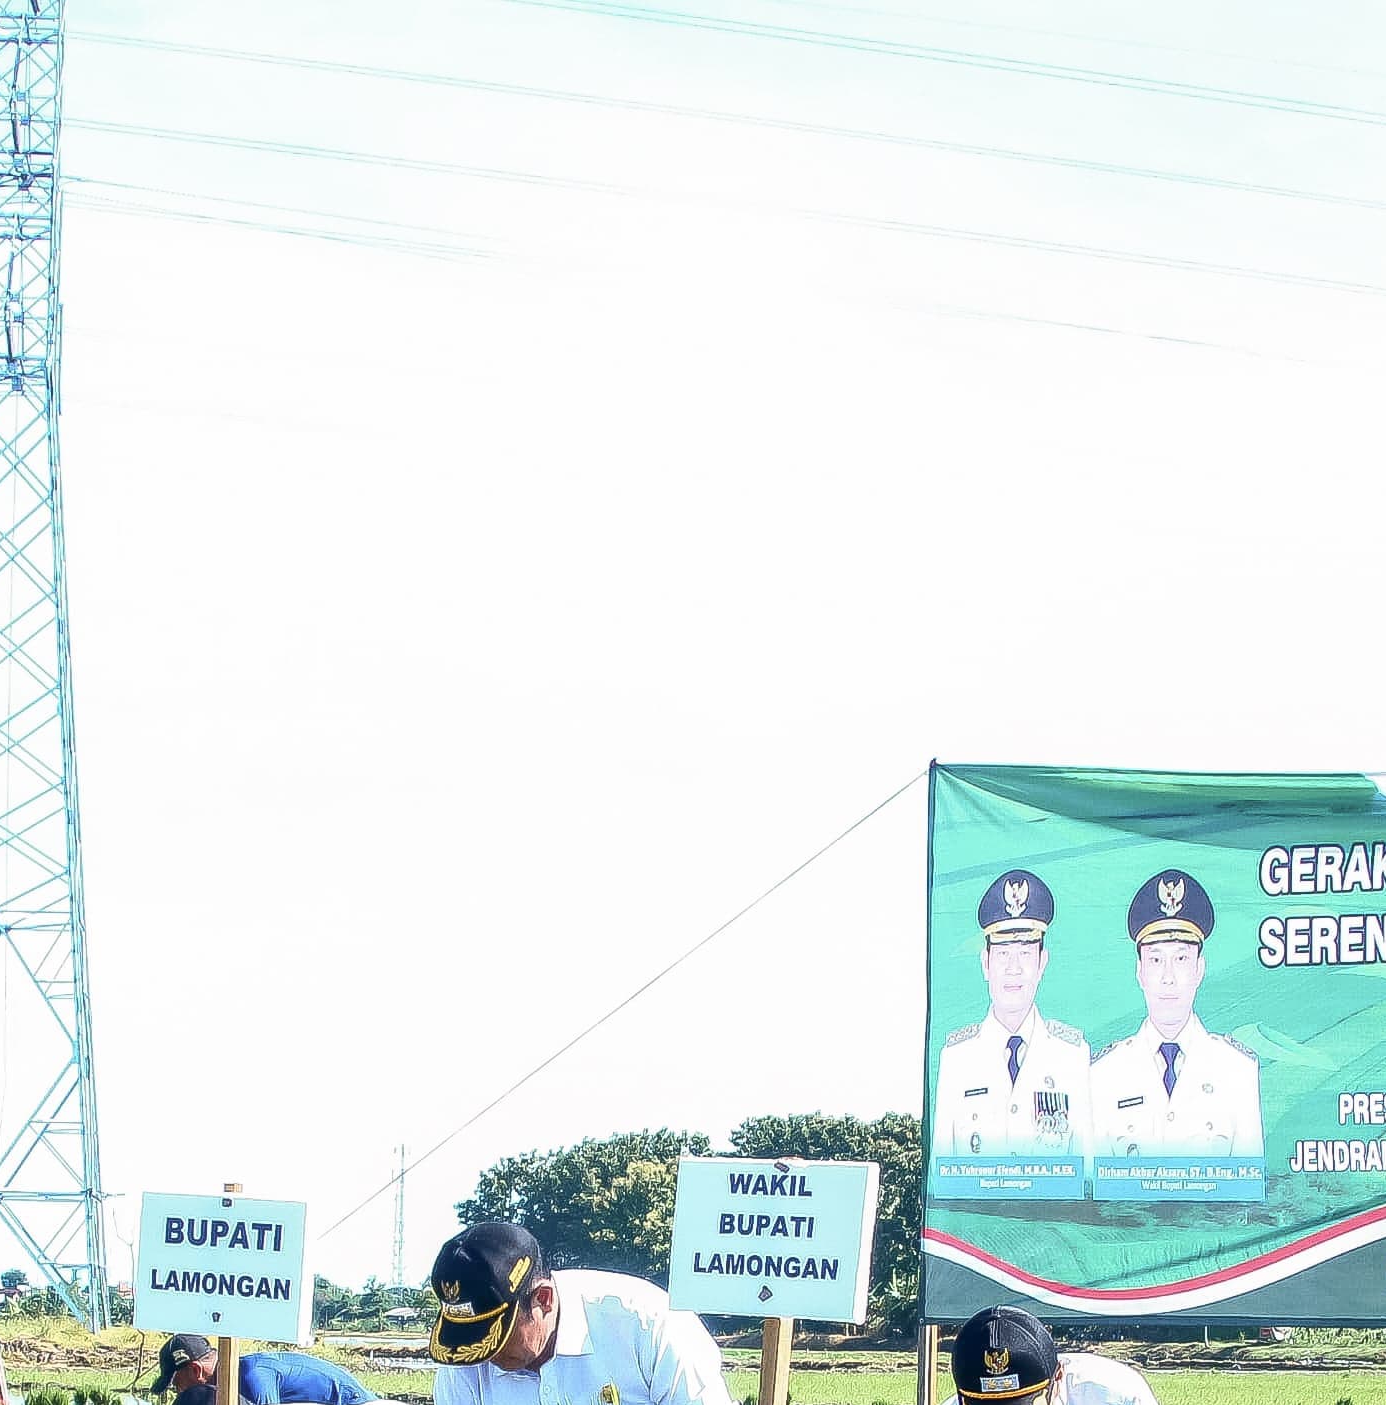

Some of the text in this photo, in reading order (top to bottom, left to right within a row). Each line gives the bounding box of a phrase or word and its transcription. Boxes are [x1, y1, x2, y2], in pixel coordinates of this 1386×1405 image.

[729, 1172, 813, 1198] WAKIL
[164, 1217, 283, 1252] BUPATI
[719, 1212, 815, 1239] BUPATI
[693, 1252, 840, 1281] LAMONGAN
[150, 1268, 292, 1301] LAMONGAN
